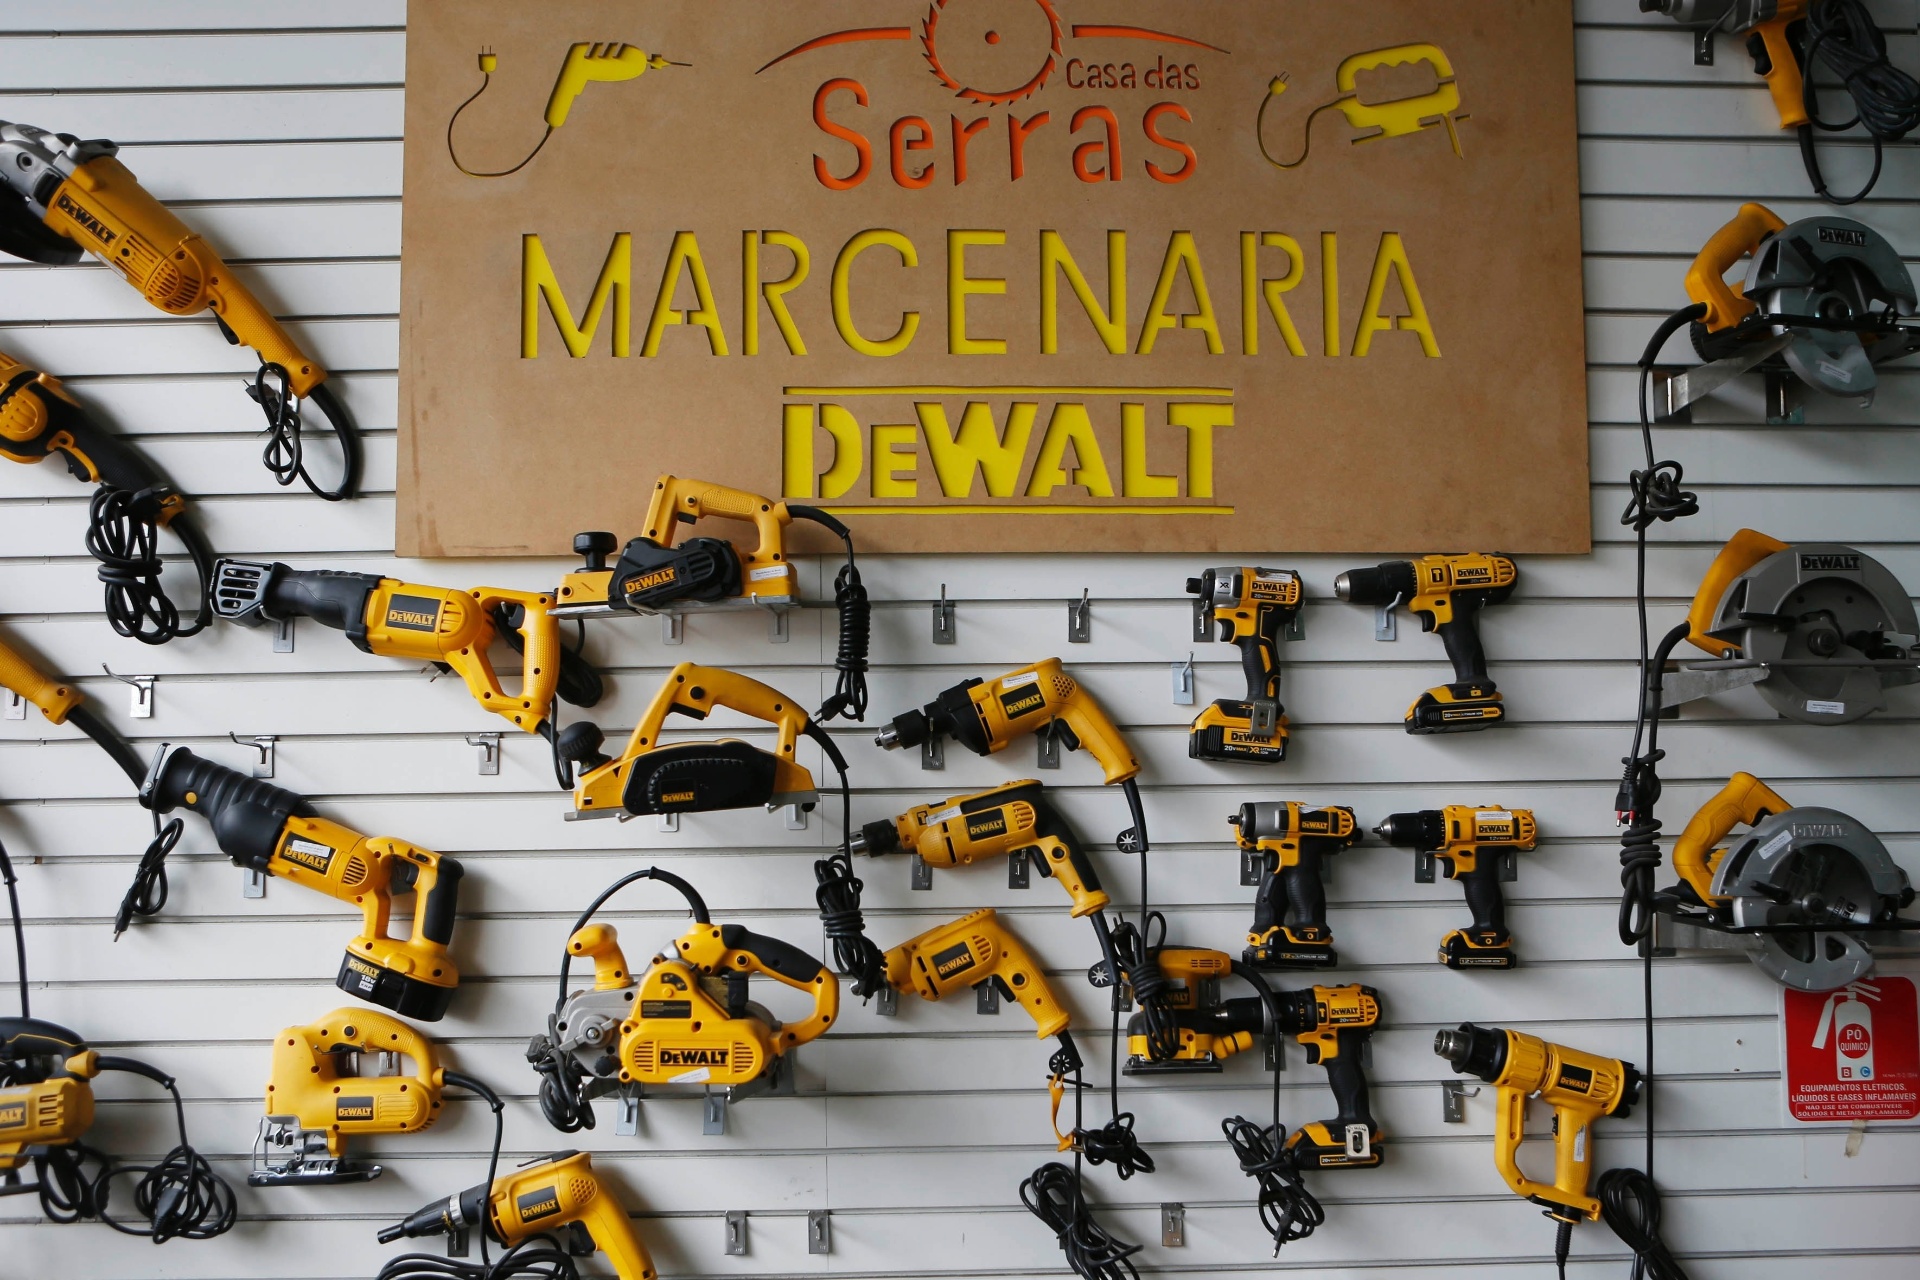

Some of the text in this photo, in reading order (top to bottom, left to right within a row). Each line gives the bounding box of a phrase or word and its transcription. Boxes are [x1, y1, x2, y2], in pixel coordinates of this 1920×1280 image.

[1066, 55, 1200, 91] Casa das
[812, 77, 1198, 191] Serras
[56, 194, 117, 244] DEWALT
[520, 227, 1442, 359] MARCENARIA
[782, 401, 1235, 500] DEWALT
[1801, 555, 1860, 570] DEWALT
[625, 567, 675, 594] DEWALT
[1457, 568, 1489, 577] DEWALT
[1252, 582, 1288, 592] DEWALT
[387, 609, 435, 626] DEWALT
[1005, 694, 1042, 715] DEWALT
[662, 792, 694, 803] DEWALT
[969, 818, 1003, 837] DEWALT
[1302, 821, 1328, 830] DEWALT
[1479, 824, 1509, 833] DEWALT
[284, 845, 328, 870] DEWALT
[349, 958, 380, 979] DEWALT
[938, 952, 971, 976] DEWALT
[660, 1051, 728, 1064] DEWALT
[1560, 1076, 1589, 1090] DEWALT
[1800, 1084, 1861, 1092] EQUIPAMENTOS
[1837, 1093, 1863, 1101] GASES
[0, 1107, 24, 1123] ALT
[337, 1106, 372, 1117] DEWALT
[522, 1200, 557, 1218] DEWALT
